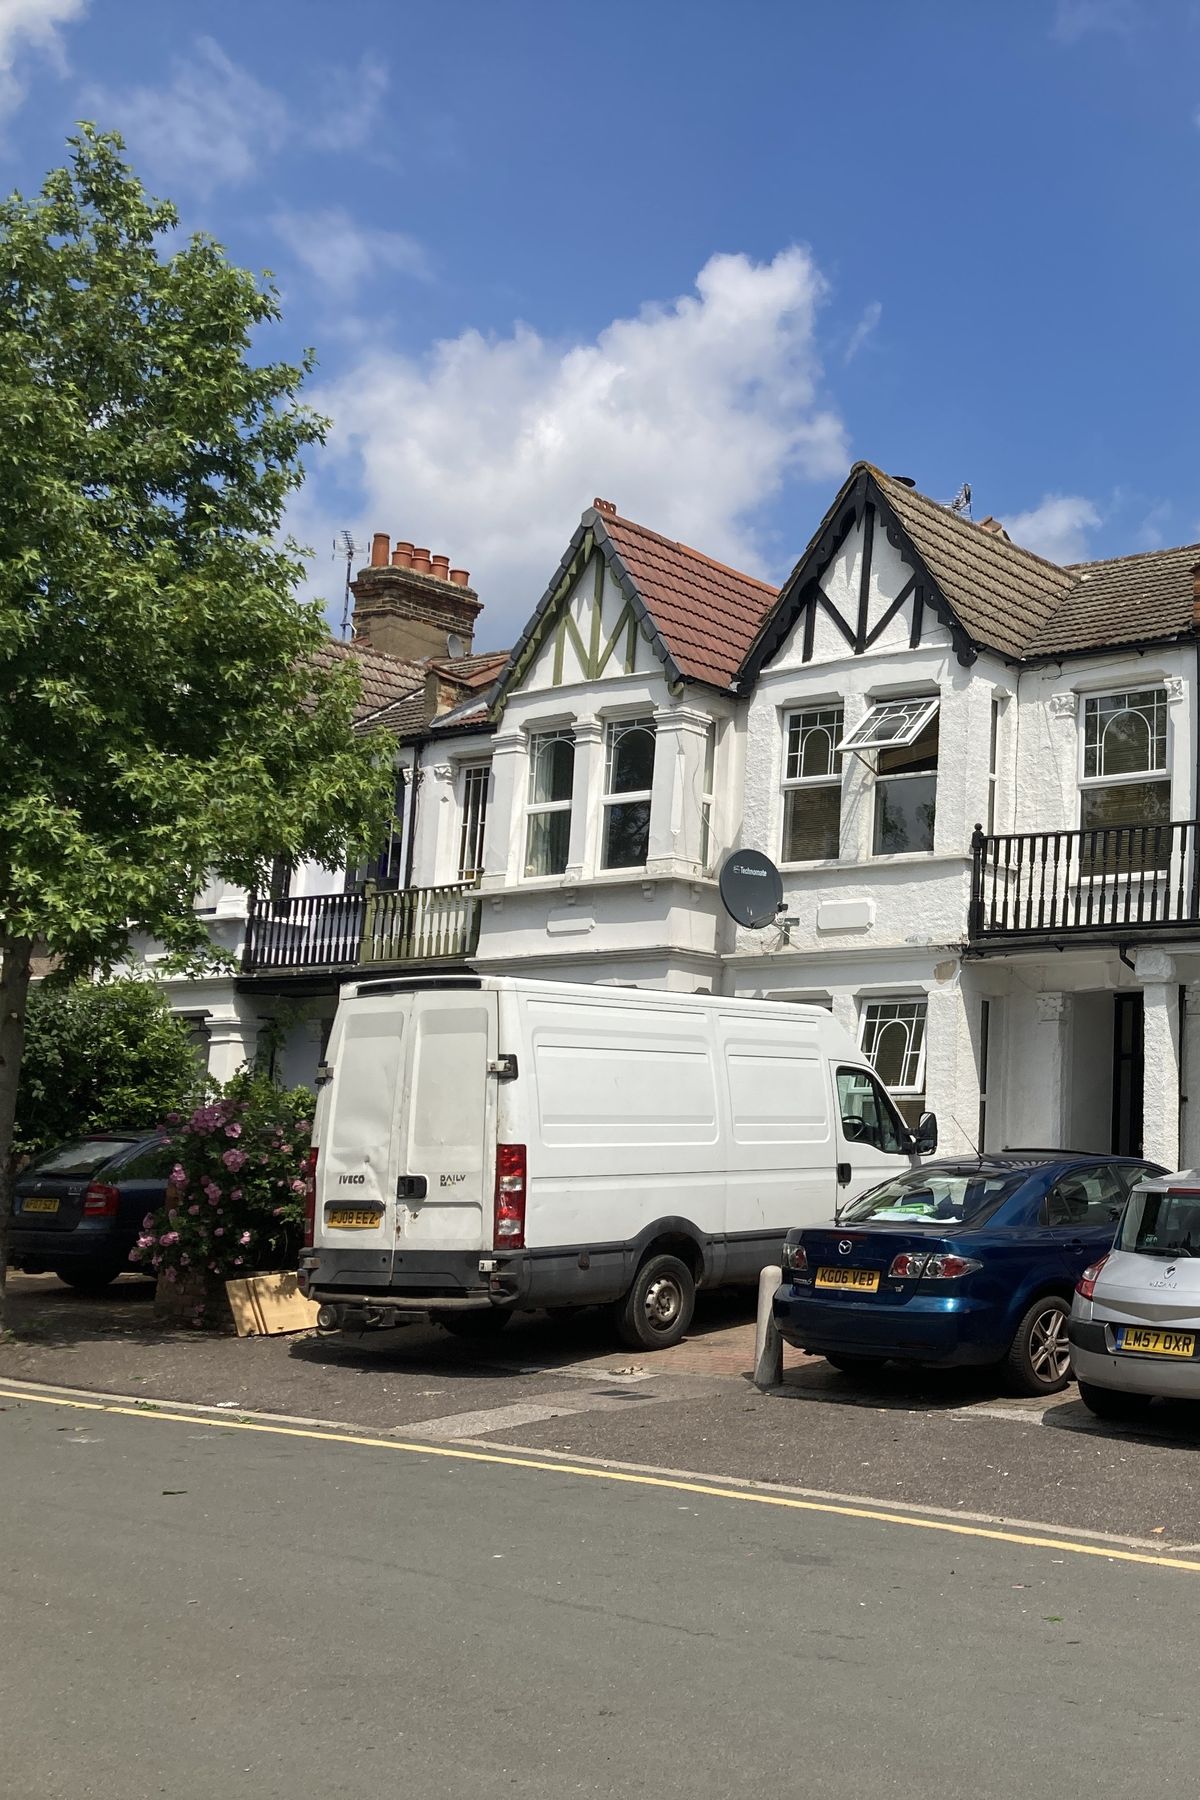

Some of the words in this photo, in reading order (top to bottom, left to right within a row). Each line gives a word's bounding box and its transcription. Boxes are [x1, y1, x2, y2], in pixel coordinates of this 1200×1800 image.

[338, 1174, 365, 1185] IVECO
[330, 1211, 353, 1224] FJ08
[355, 1211, 376, 1225] EEZ
[820, 1268, 848, 1283] KG06
[852, 1270, 875, 1286] VEB
[1124, 1330, 1160, 1349] LM57
[1163, 1335, 1192, 1353] OXR
